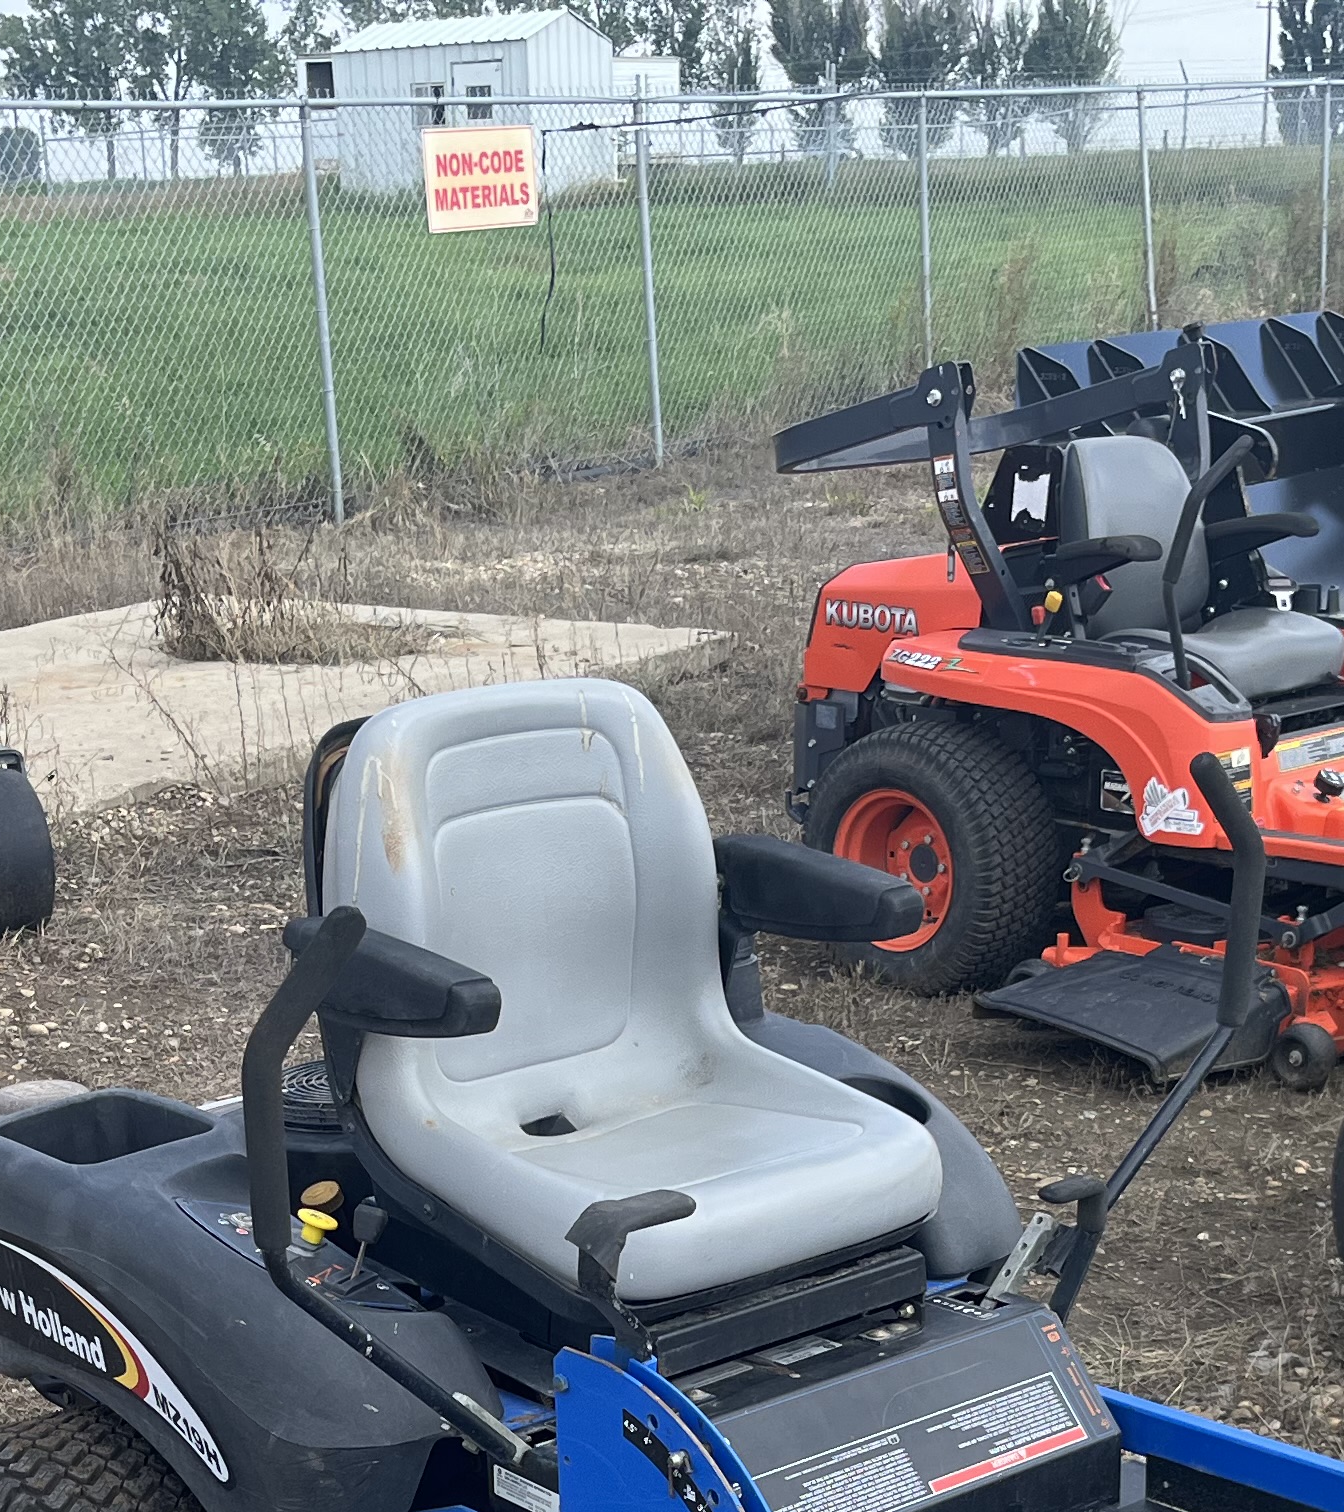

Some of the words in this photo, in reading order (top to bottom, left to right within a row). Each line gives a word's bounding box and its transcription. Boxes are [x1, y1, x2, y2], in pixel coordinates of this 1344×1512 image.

[435, 149, 525, 177] NON-CODE
[434, 182, 530, 212] MATERIALS
[825, 598, 920, 637] KUBOTA
[886, 647, 943, 671] ZG222
[18, 1289, 107, 1373] Holland
[152, 1383, 222, 1474] MZ19H
